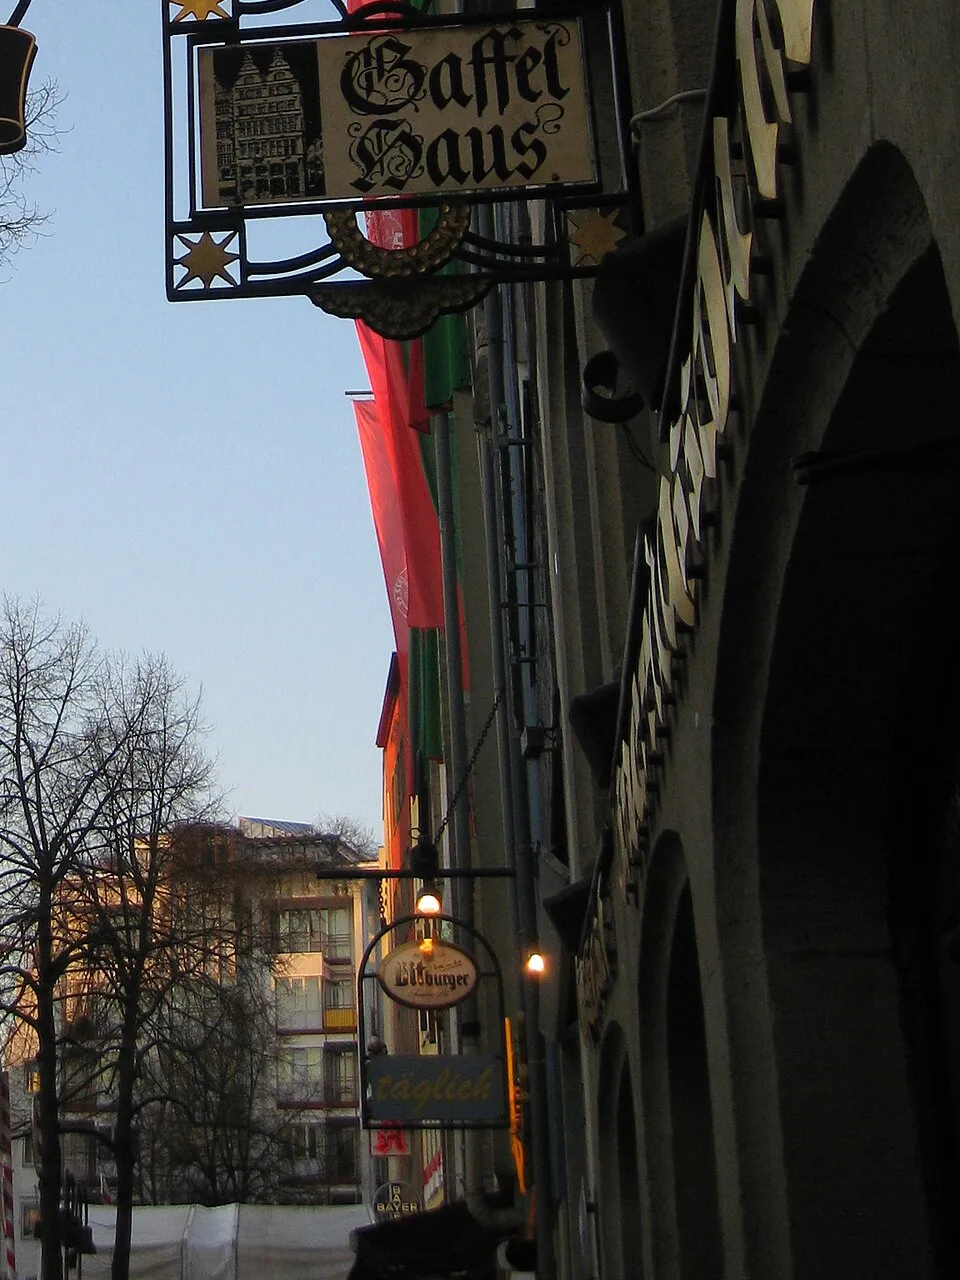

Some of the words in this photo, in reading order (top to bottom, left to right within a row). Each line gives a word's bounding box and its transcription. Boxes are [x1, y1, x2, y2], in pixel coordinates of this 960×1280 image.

[341, 23, 571, 117] Gaffel
[347, 103, 565, 192] Haus
[395, 959, 470, 991] Bitburger
[376, 1202, 418, 1212] BAYER
